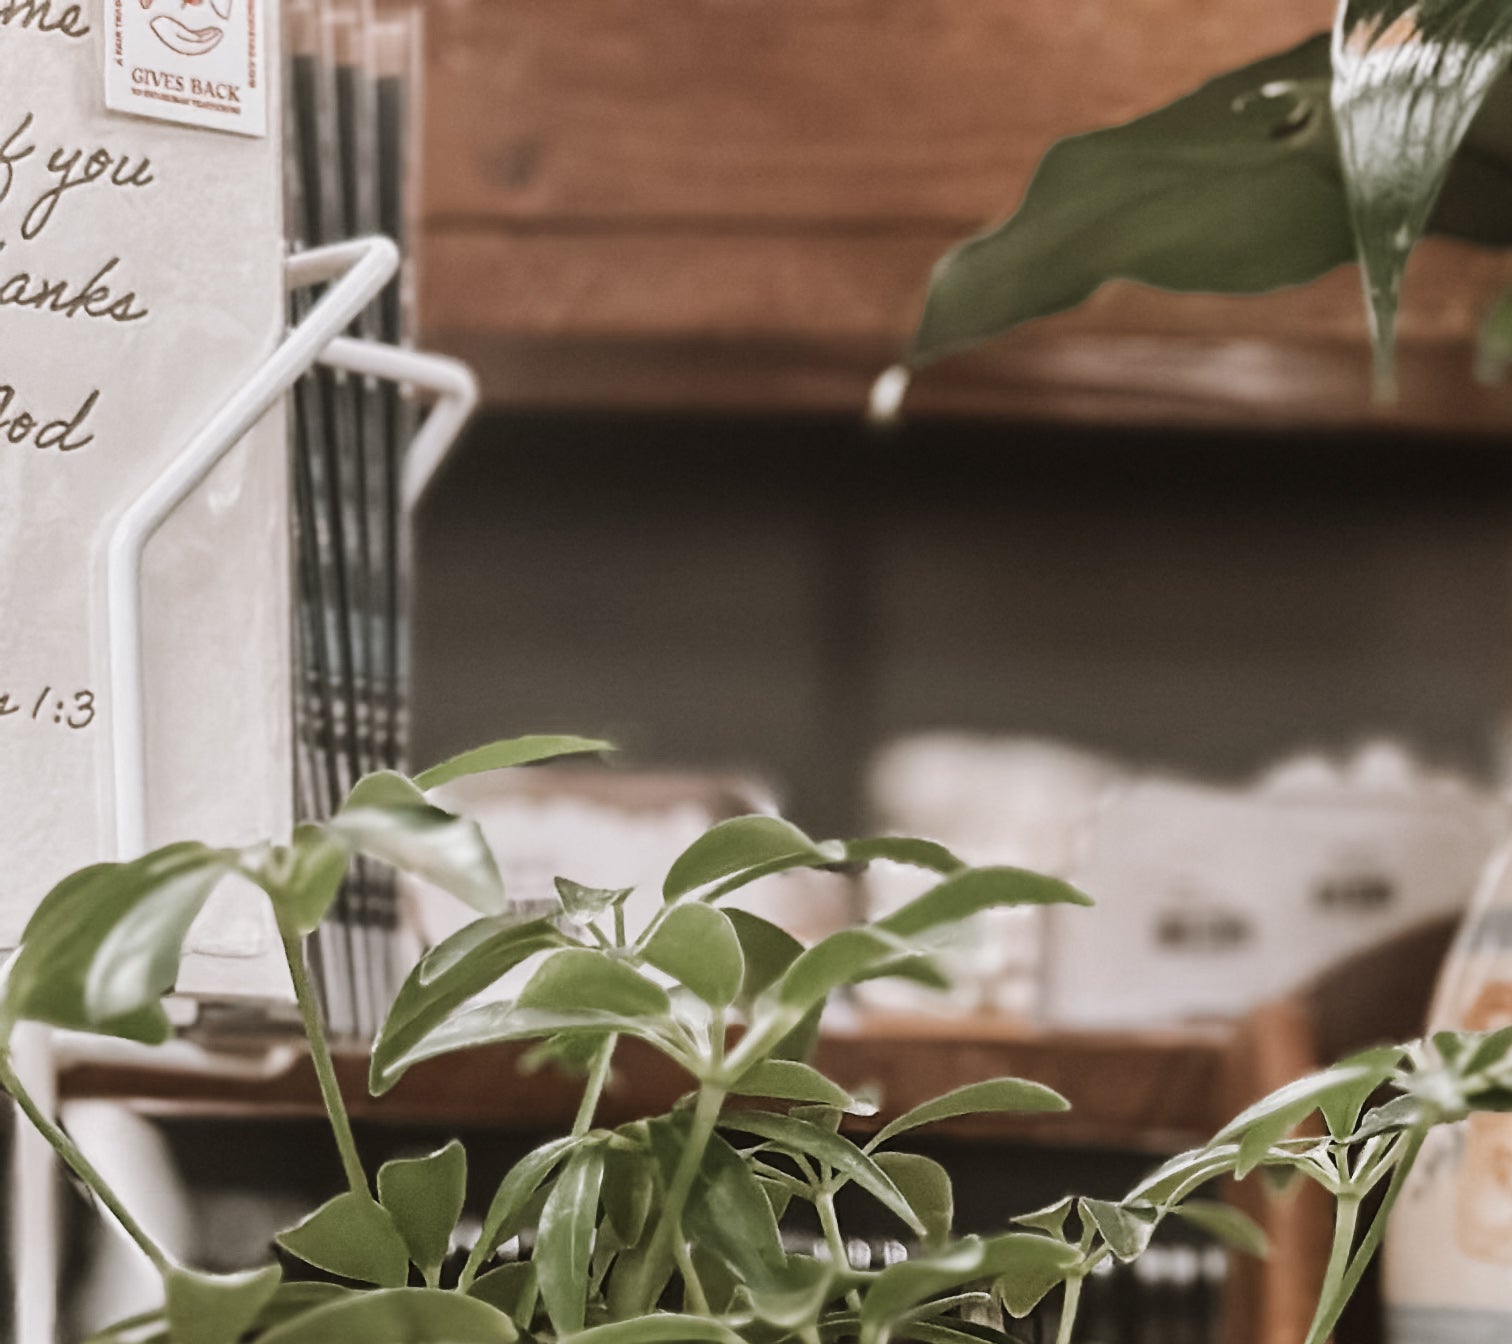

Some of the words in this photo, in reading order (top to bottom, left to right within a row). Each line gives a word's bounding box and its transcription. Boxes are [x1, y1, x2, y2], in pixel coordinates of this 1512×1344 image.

[131, 67, 184, 92] GIVES
[190, 77, 240, 102] BACK
[21, 147, 153, 240] you
[0, 256, 148, 321] anks
[32, 686, 95, 729] 1:3
